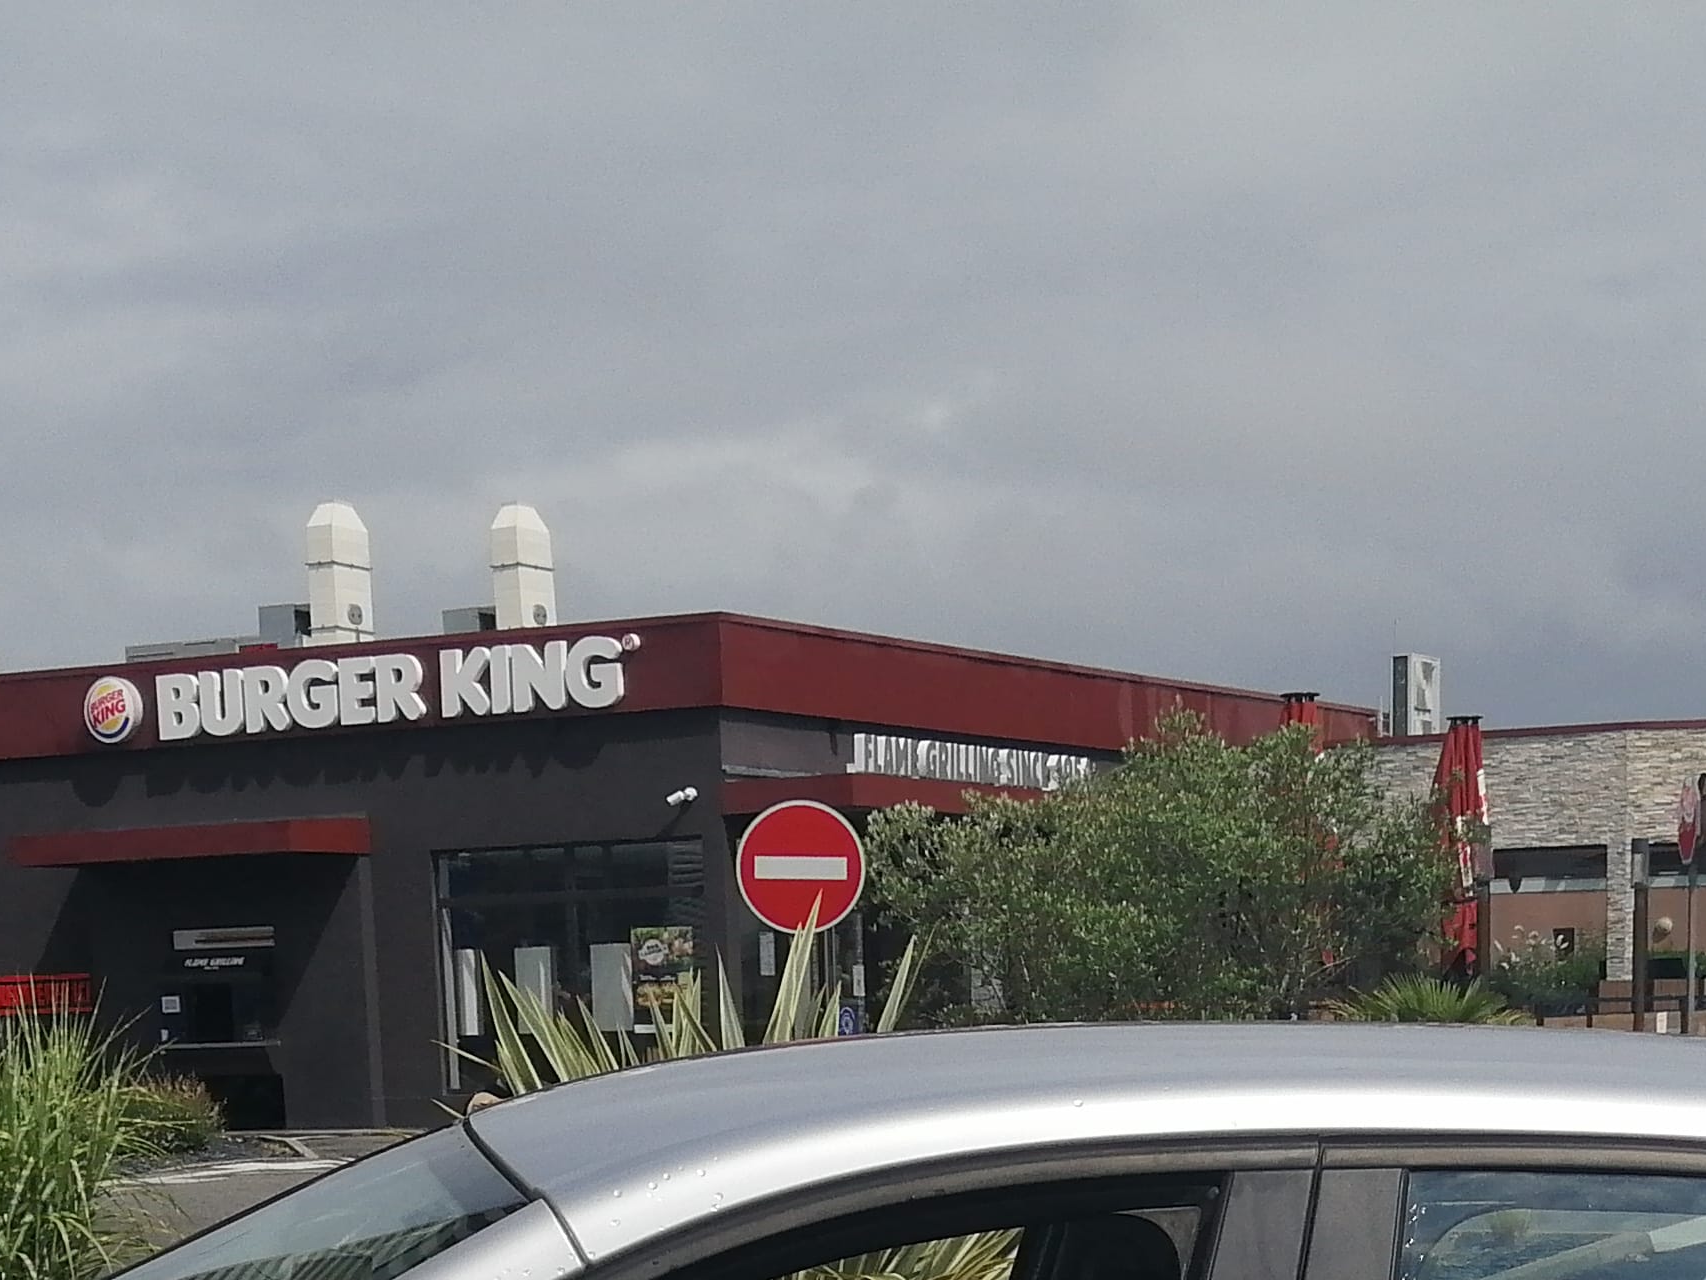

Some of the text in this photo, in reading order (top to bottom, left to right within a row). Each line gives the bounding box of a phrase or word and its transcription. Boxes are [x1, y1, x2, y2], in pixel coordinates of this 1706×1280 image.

[90, 689, 124, 714] BURGER
[155, 635, 625, 741] BURGER KING
[92, 699, 126, 729] KING
[922, 739, 1001, 785] GRILLING
